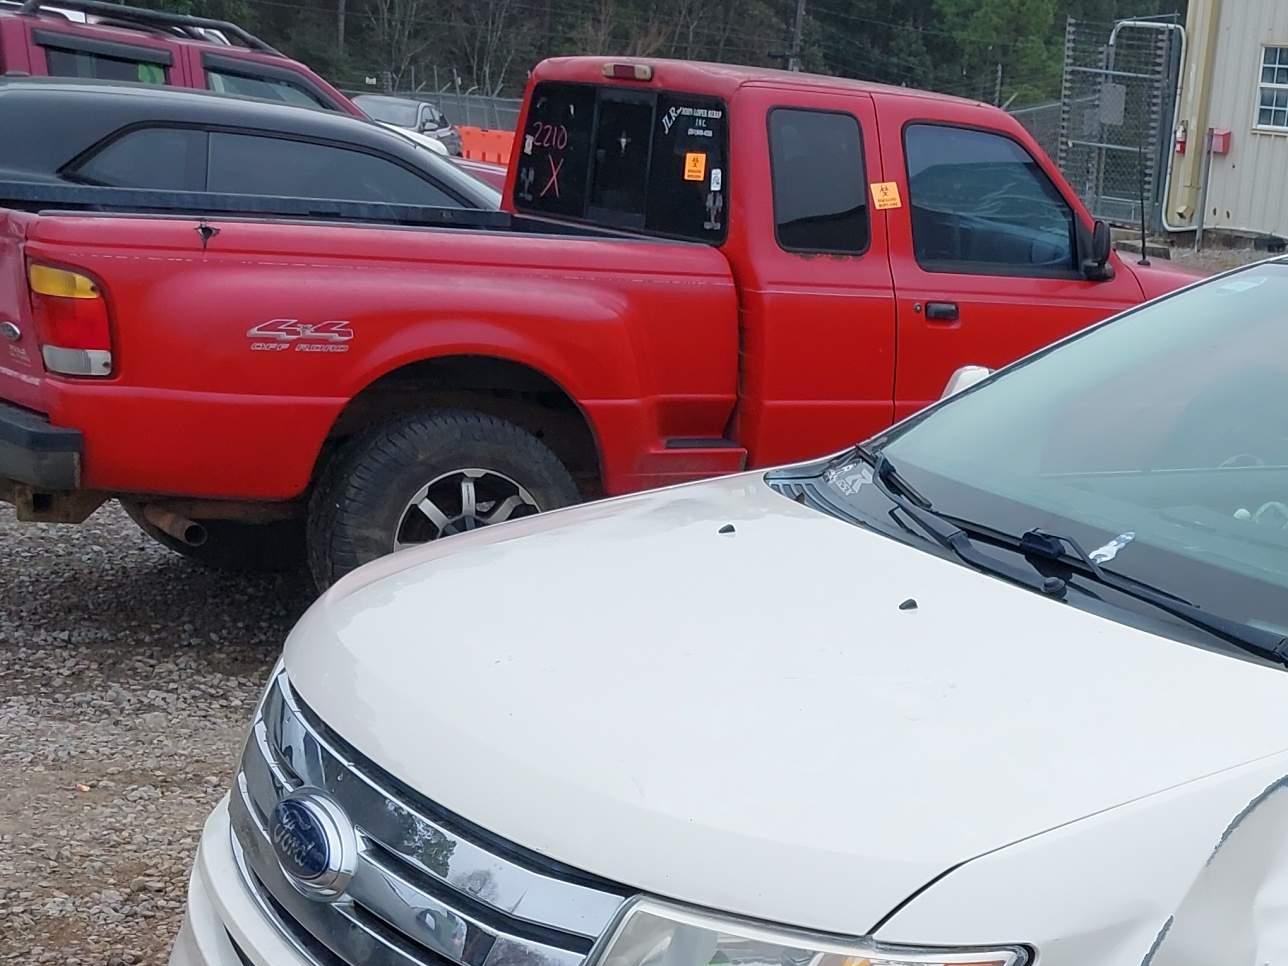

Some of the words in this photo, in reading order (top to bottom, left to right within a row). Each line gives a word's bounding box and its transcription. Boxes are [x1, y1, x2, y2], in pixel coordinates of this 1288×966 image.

[532, 121, 568, 149] 2210
[250, 342, 290, 351] OFF
[295, 343, 349, 352] ROAD
[273, 805, 316, 867] Ford
